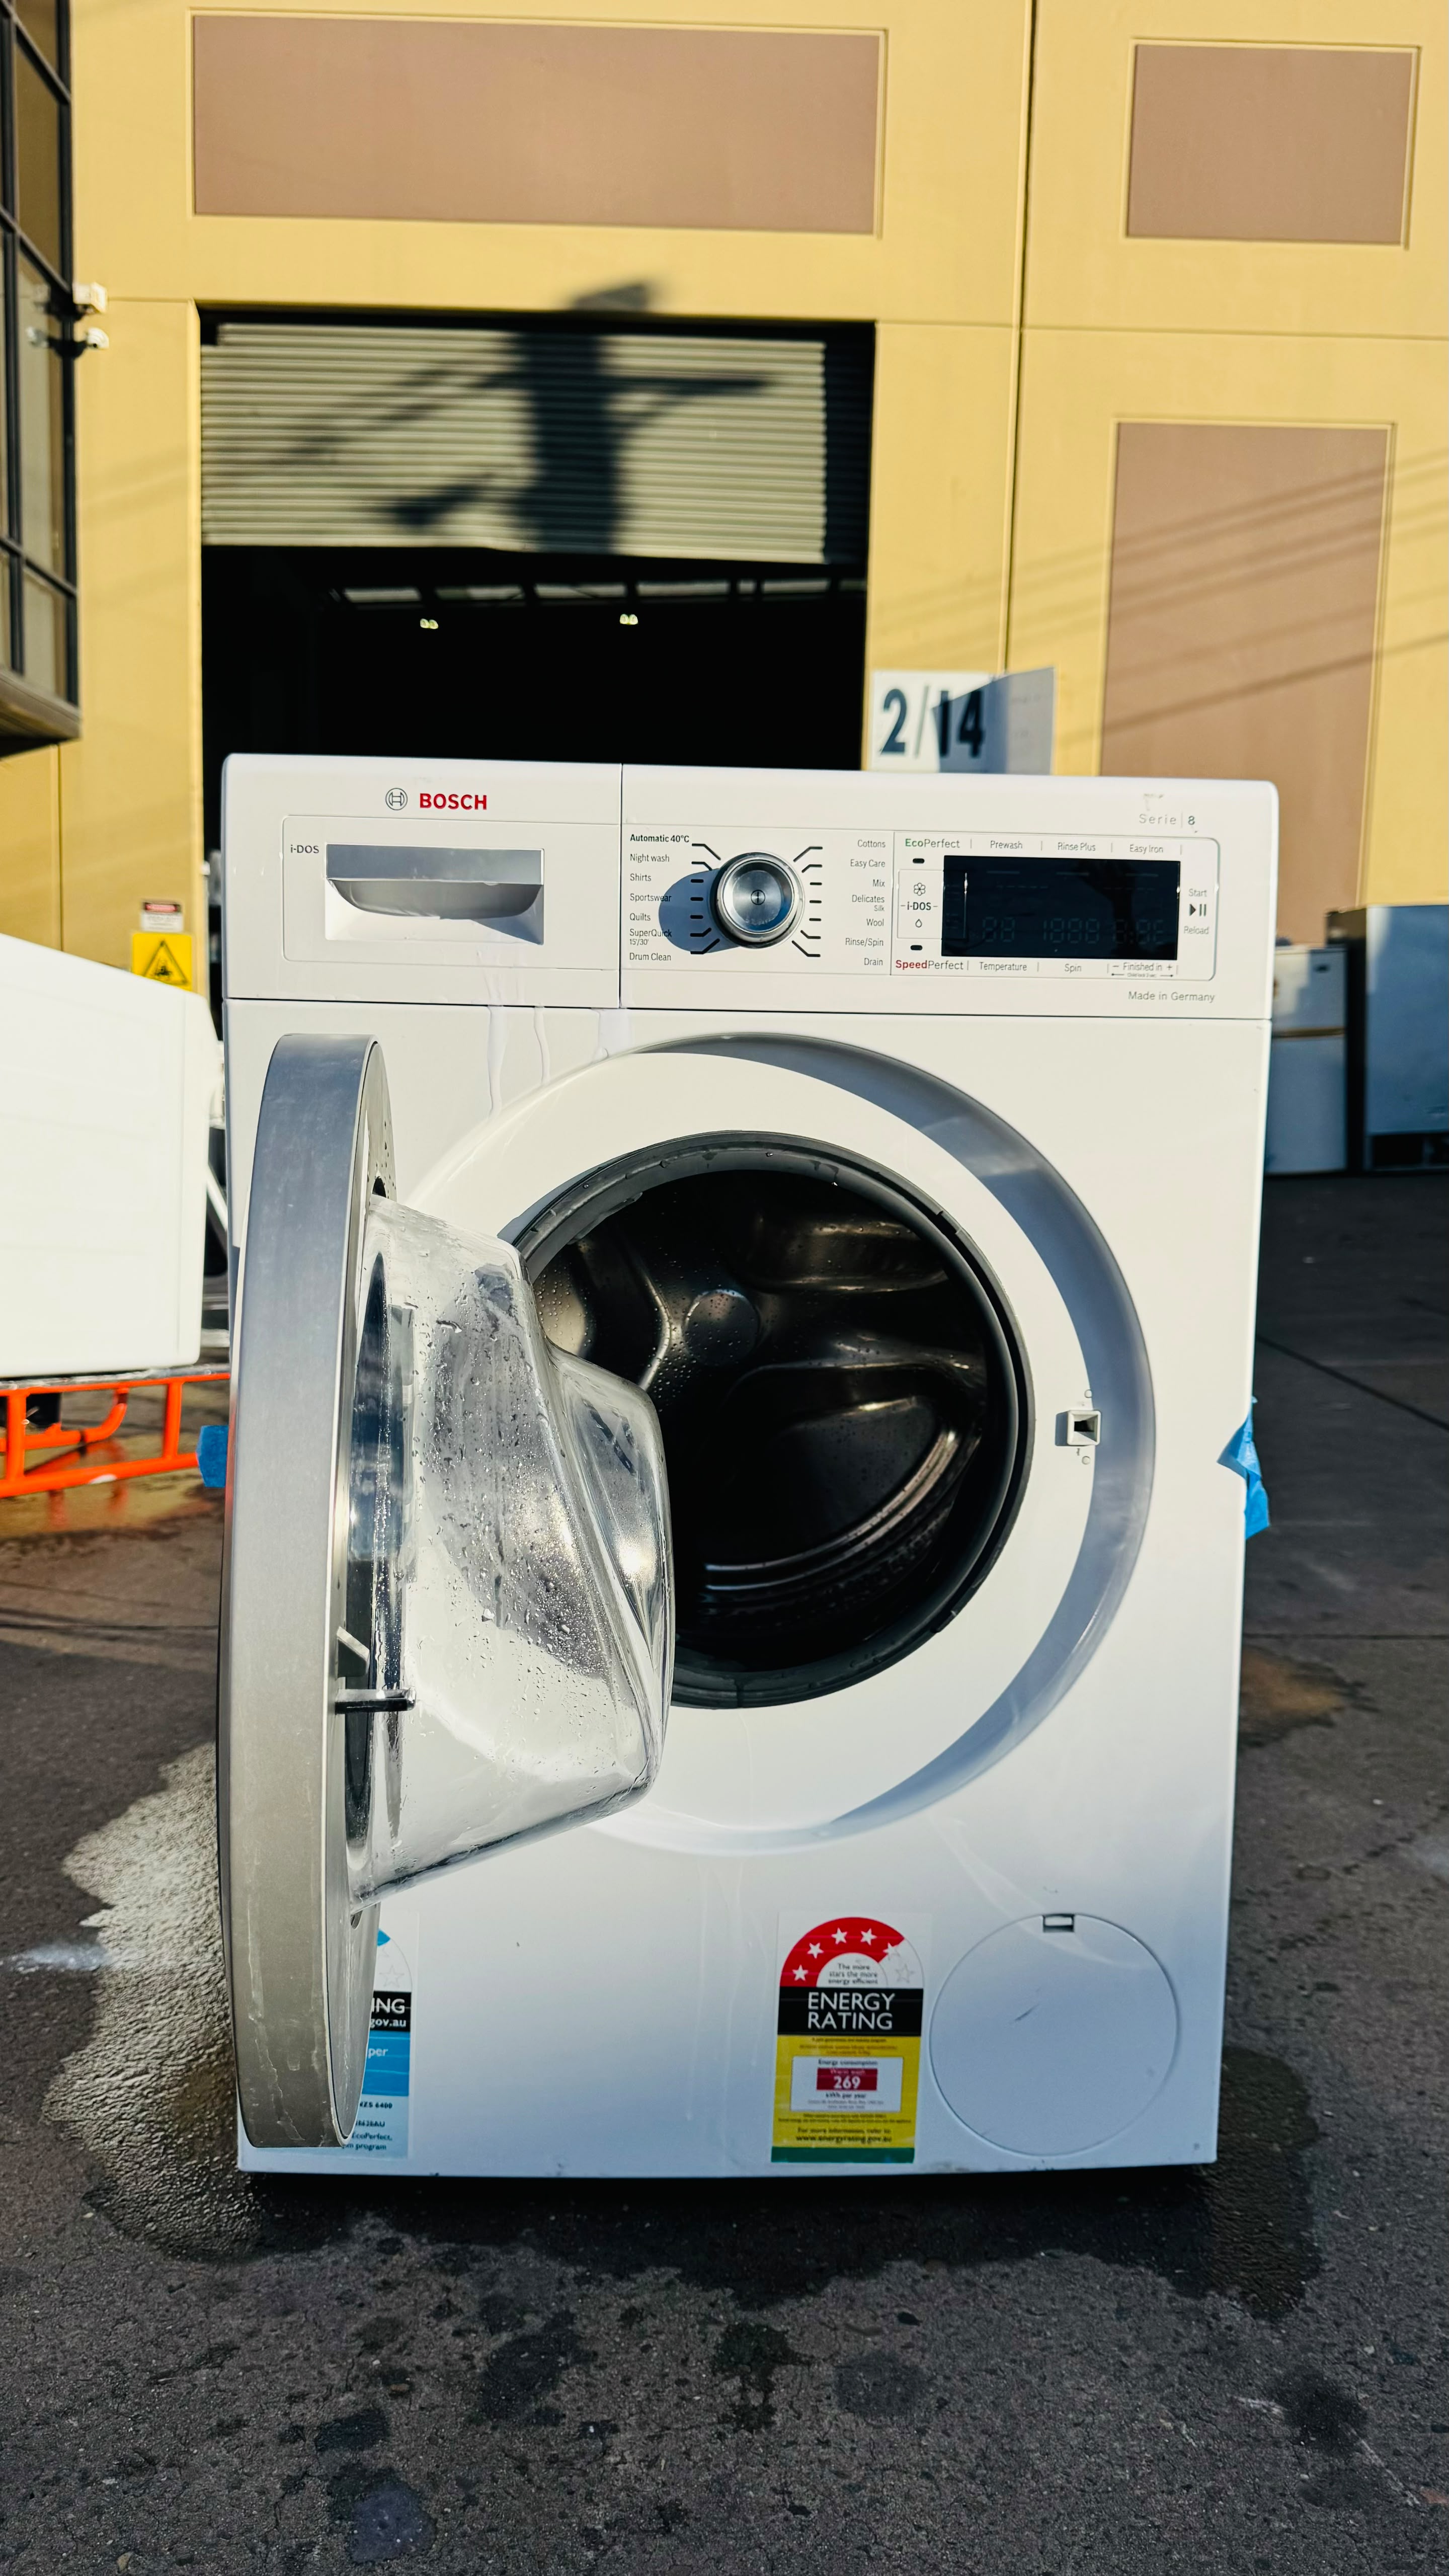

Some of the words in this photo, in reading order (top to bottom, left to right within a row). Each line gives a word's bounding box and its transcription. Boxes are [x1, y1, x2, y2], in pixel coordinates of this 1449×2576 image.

[880, 685, 985, 759] 2/14
[420, 793, 487, 810] BOSCH
[1139, 814, 1176, 825] Serie
[1187, 815, 1195, 826] 8
[630, 834, 669, 842] Automatic
[670, 834, 689, 843] 40°C
[857, 839, 886, 848] Cottons
[290, 844, 319, 854] i-DOS
[905, 839, 960, 849] EcoPerfect
[990, 840, 1022, 850] Prewash
[1058, 842, 1078, 852] Rinse
[1080, 842, 1096, 852] Plus
[1130, 844, 1146, 854] Easy
[1148, 845, 1164, 853] Iron
[630, 853, 649, 863] Night
[650, 854, 670, 862] wash
[850, 859, 866, 869] Easy
[868, 859, 886, 868] Care
[630, 873, 652, 882] Shirts
[872, 879, 886, 888] Mix
[1188, 888, 1207, 897] Start
[630, 893, 672, 904] Sportswear
[852, 895, 884, 904] Delicates
[907, 901, 932, 911] i-DOS
[629, 913, 651, 922] Quilts
[866, 919, 884, 927] Wool
[629, 928, 672, 938] SuperQuick
[1184, 925, 1209, 935] Reload
[845, 937, 884, 947] Rinse/Spin
[629, 952, 649, 961] Drum
[651, 953, 672, 961] Clean
[864, 957, 883, 966] Drain
[896, 959, 964, 971] SpeedPerfect
[979, 961, 1027, 973] Temperature
[1064, 963, 1082, 974] Spin
[1123, 962, 1154, 971] Finished
[1156, 963, 1162, 971] in
[1129, 991, 1155, 1000] Made
[1159, 992, 1167, 1000] in
[1171, 992, 1215, 1003] Germany
[371, 1997, 405, 2014] ING
[808, 1991, 895, 2011] ENERGY
[808, 2011, 893, 2030] RATING
[834, 2076, 861, 2089] 269
[355, 2143, 387, 2151] program
